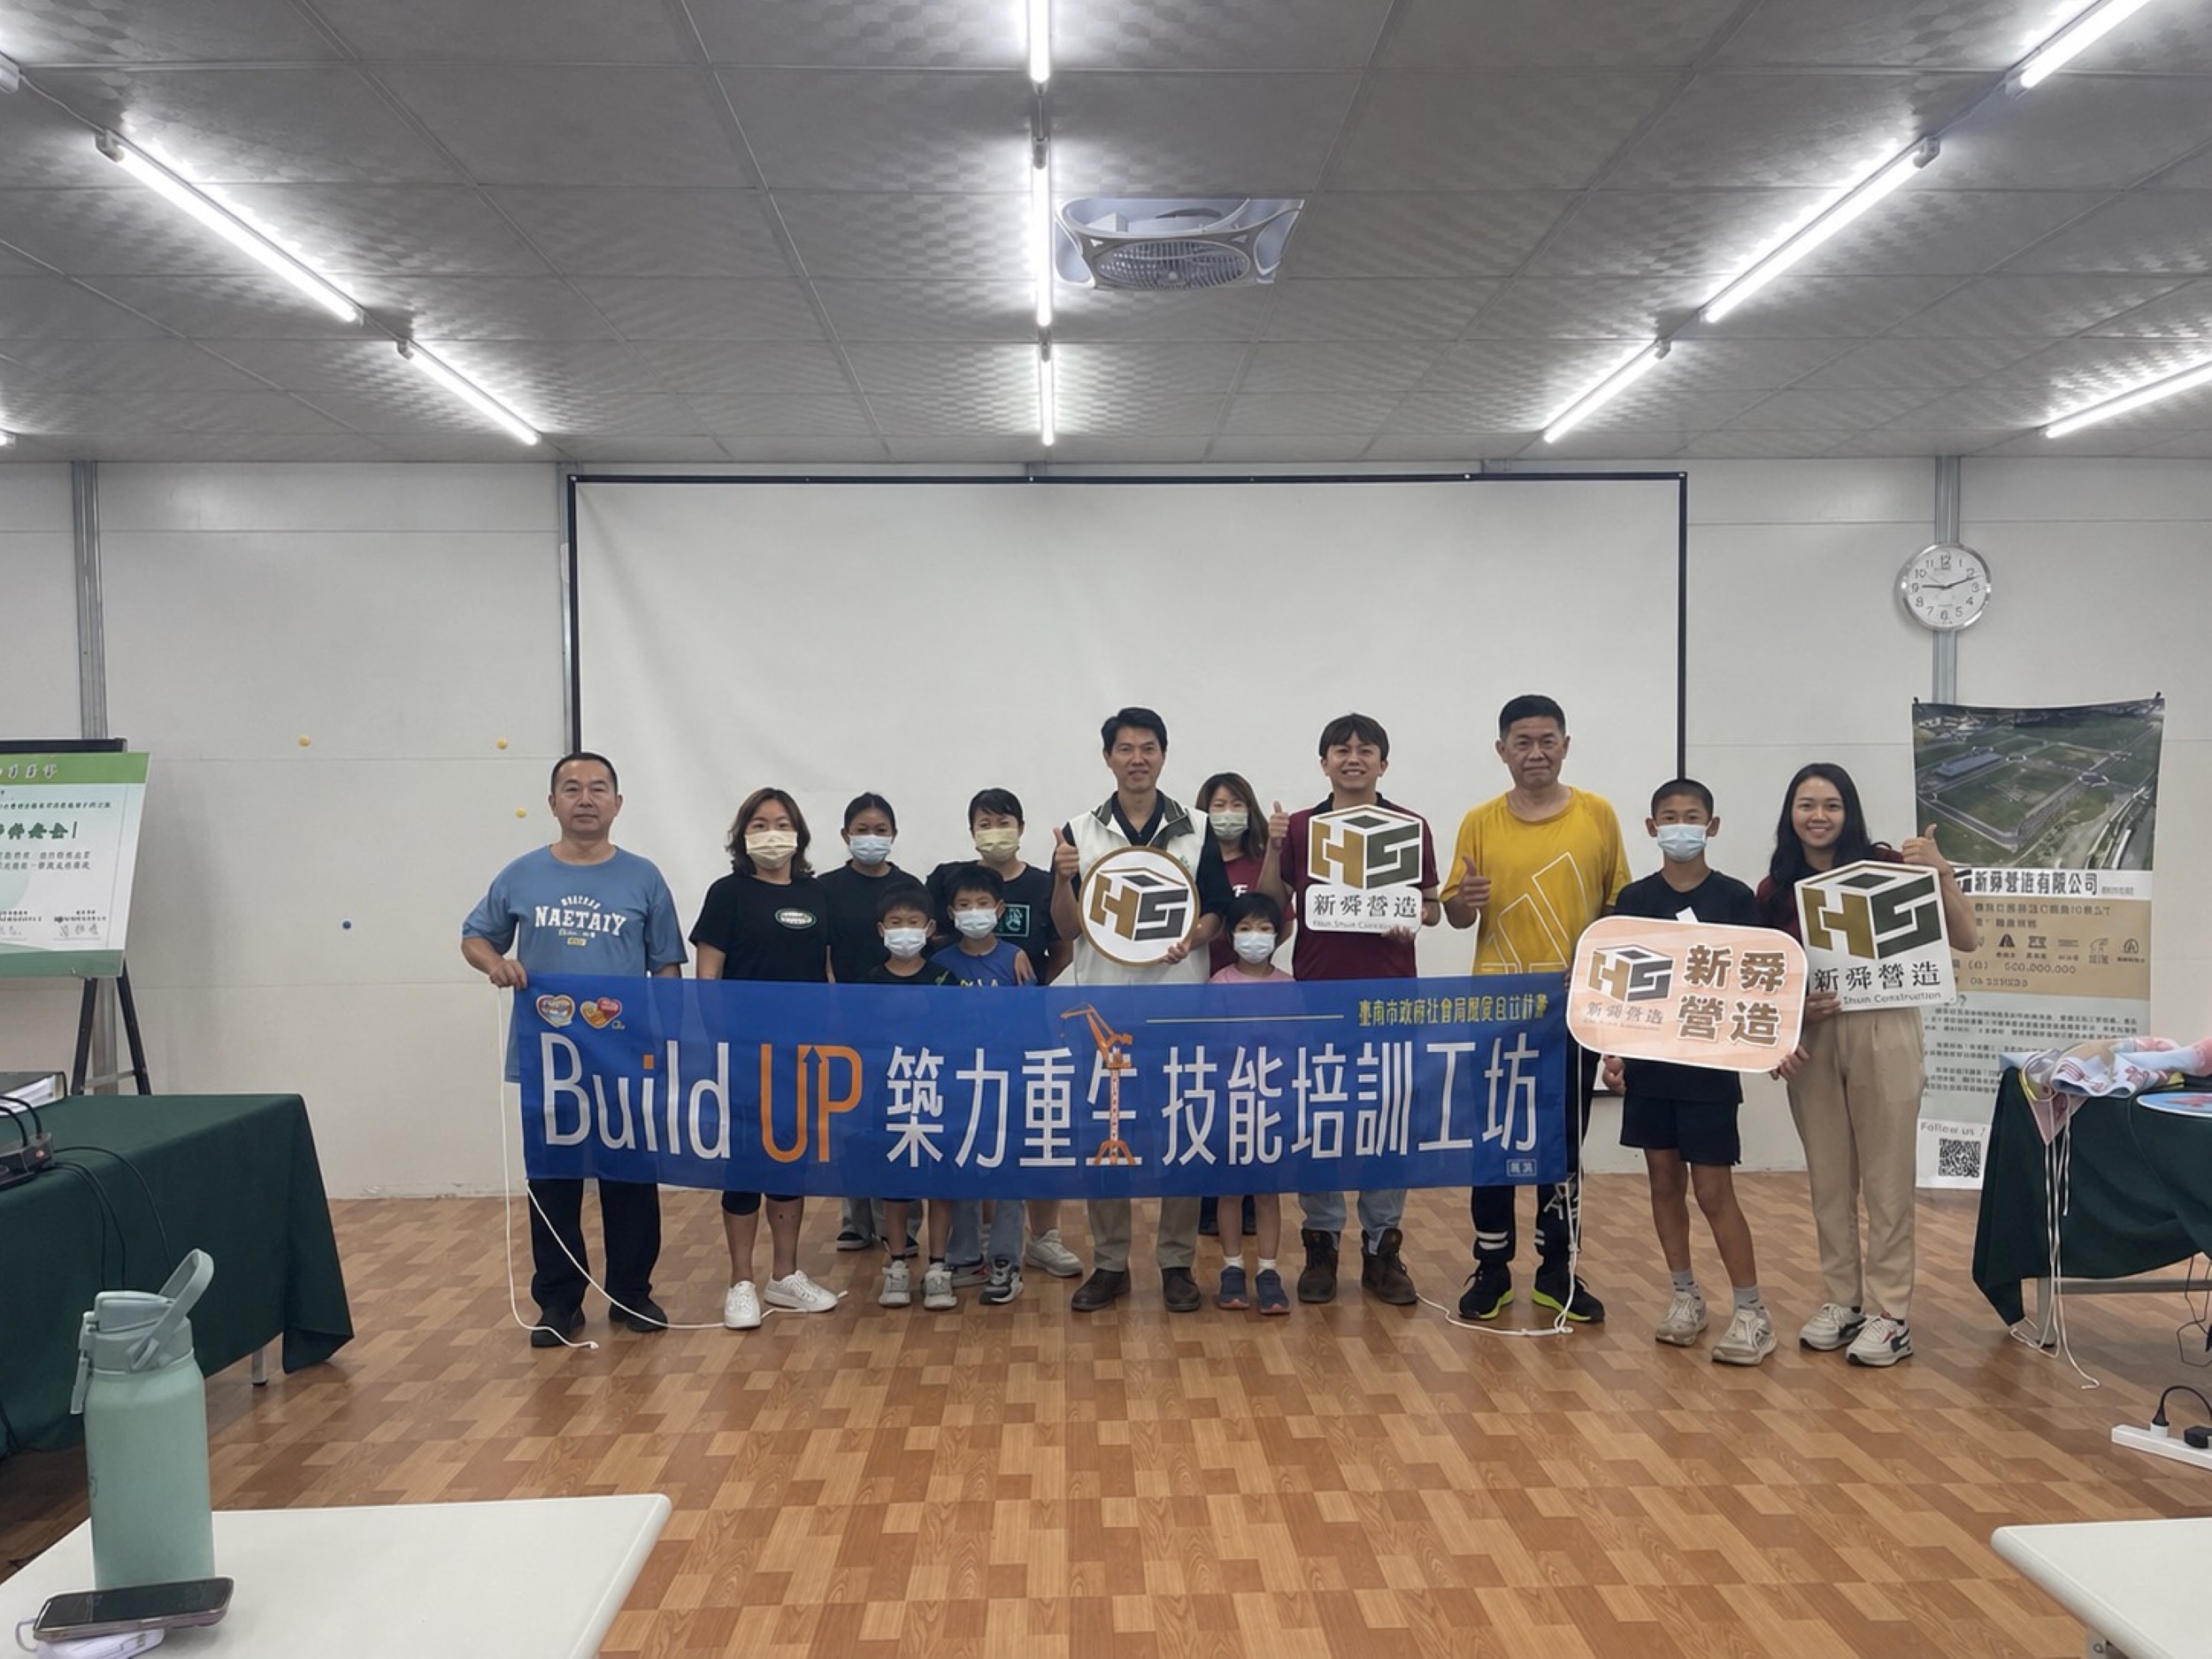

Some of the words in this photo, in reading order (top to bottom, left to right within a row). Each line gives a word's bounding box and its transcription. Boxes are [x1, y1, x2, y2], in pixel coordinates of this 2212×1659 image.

[1313, 894, 1416, 918] 新舜營造
[1684, 944, 1786, 992] 新舜
[1814, 961, 1940, 993] 新舜營造
[1678, 995, 1782, 1048] 營造
[540, 1032, 731, 1160] Build
[760, 1042, 864, 1164] UP
